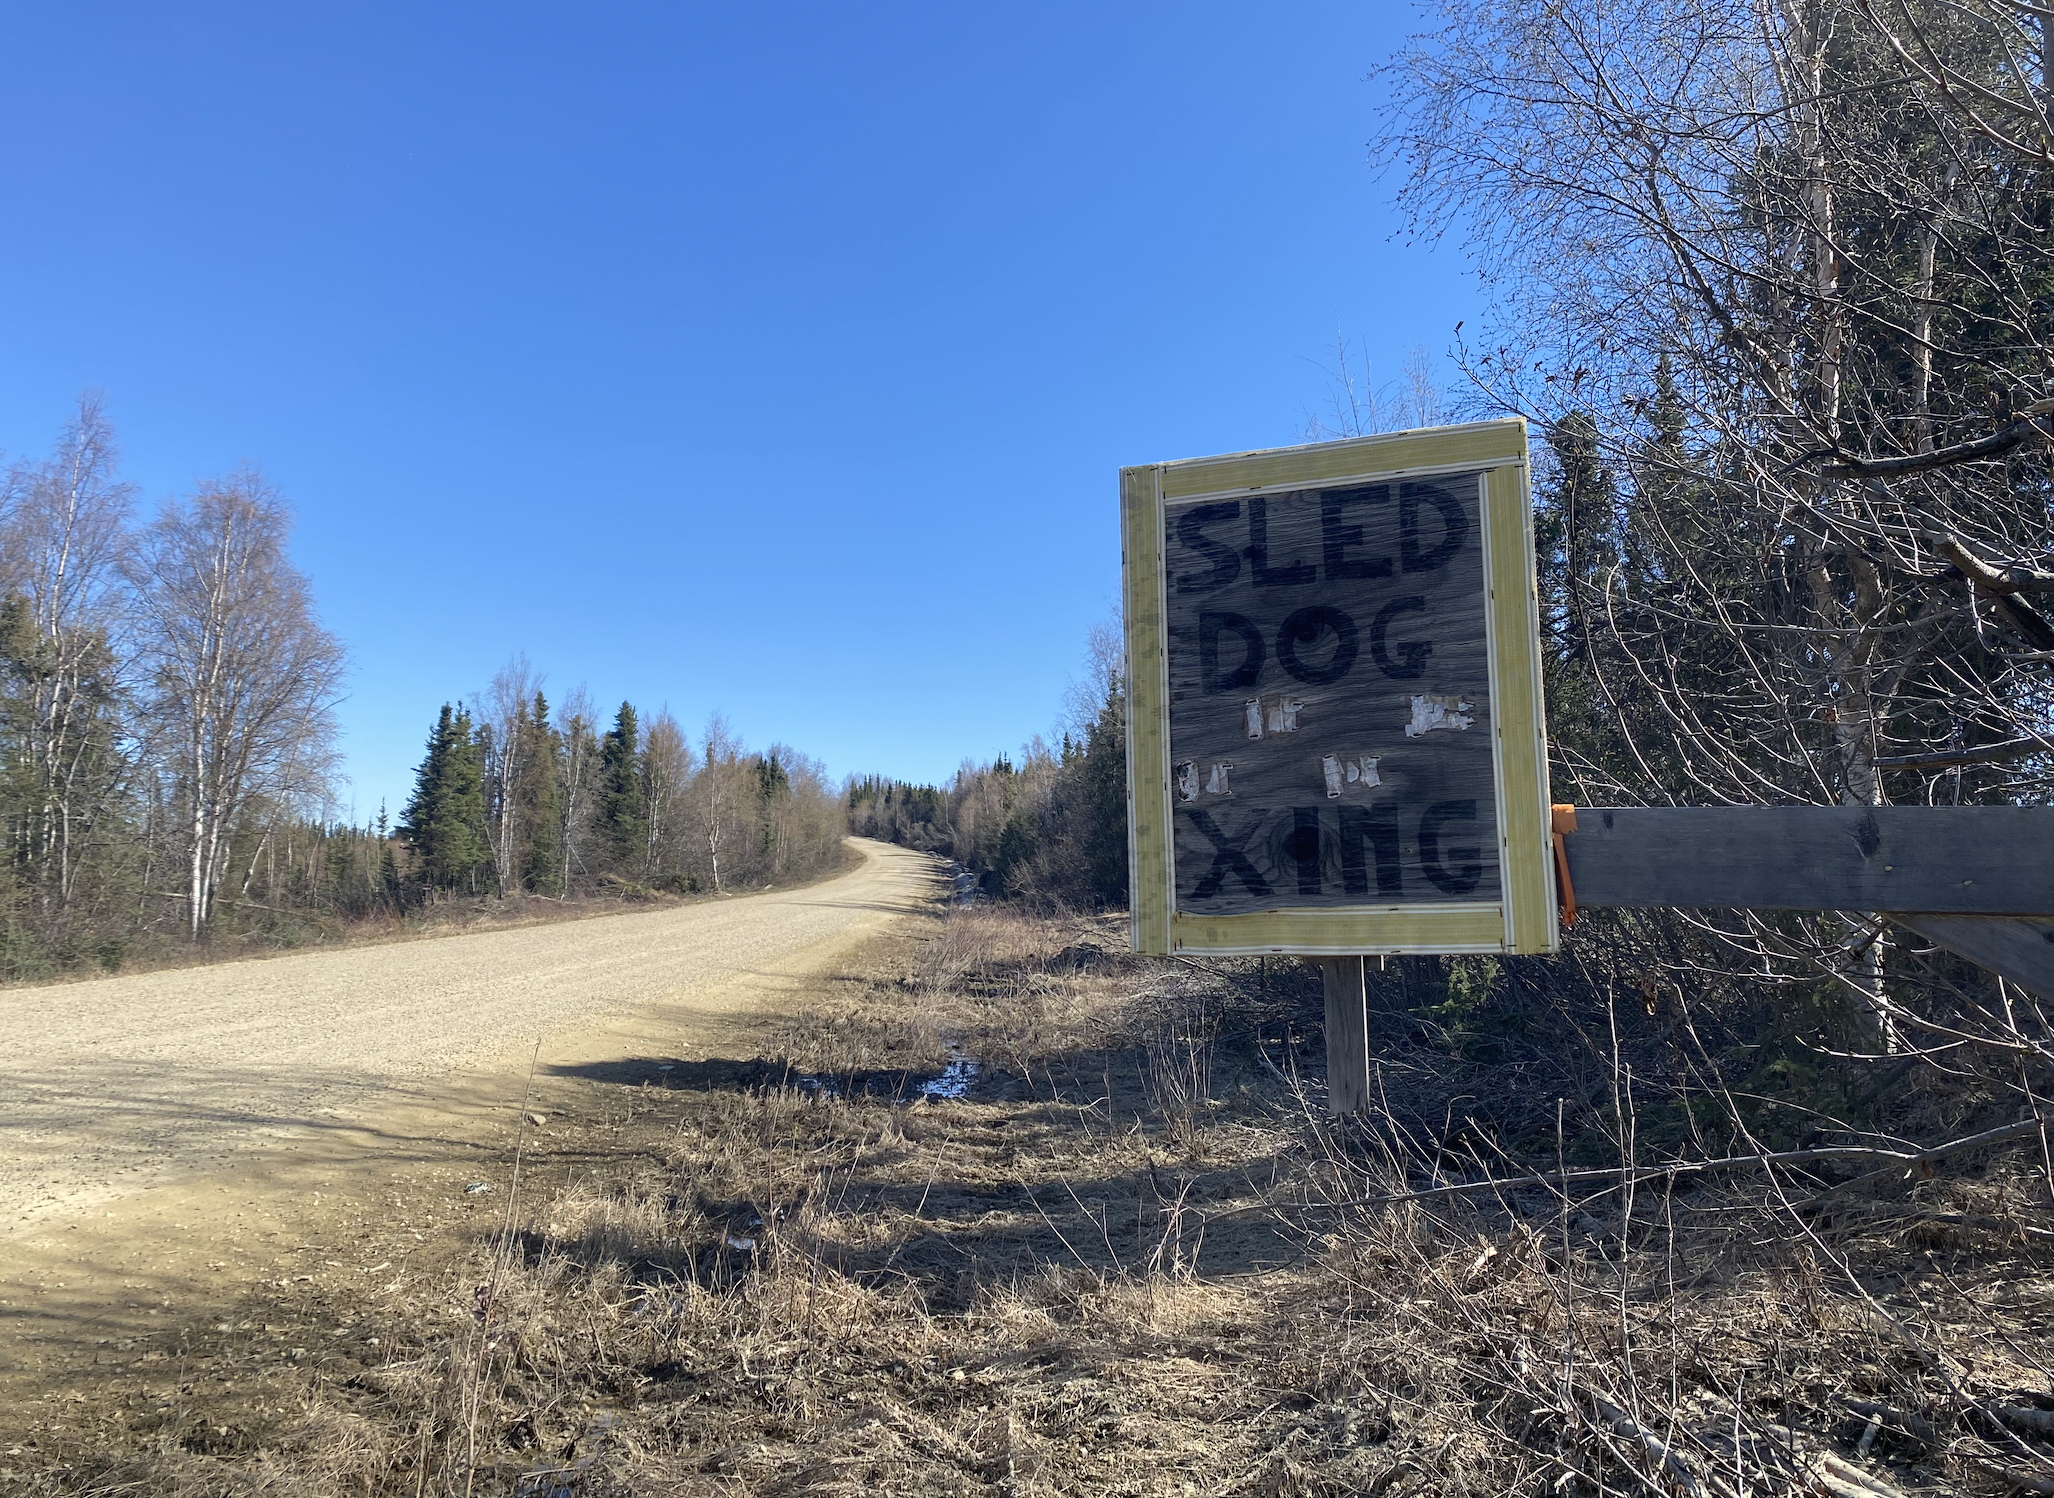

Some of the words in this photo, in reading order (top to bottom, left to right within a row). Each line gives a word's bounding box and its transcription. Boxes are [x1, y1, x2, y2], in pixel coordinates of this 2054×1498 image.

[1177, 482, 1468, 593] SLED
[1199, 597, 1432, 692] DOG
[1188, 800, 1482, 899] XING
